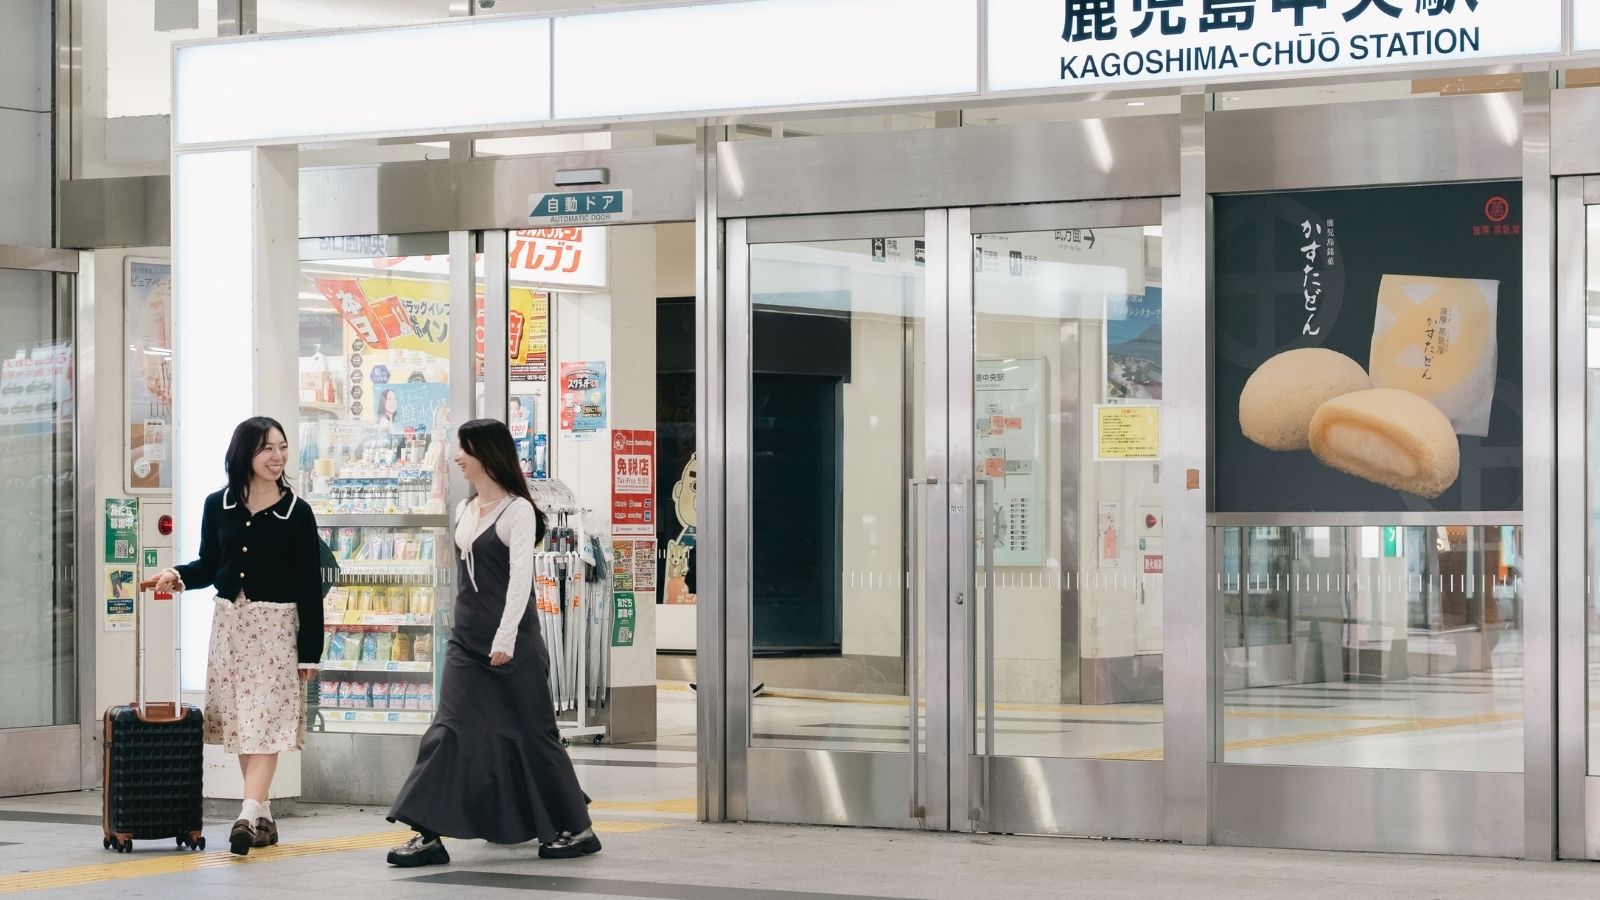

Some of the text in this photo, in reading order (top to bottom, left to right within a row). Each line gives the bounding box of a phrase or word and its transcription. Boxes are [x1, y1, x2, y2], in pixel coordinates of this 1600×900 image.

[1062, 0, 1480, 43] 鹿児島
[1060, 26, 1480, 79] KAGOSHIMA-CHŪŌ STATION
[547, 195, 614, 212] 自動ドア
[550, 215, 589, 223] AUTOMATIC
[1301, 219, 1321, 336] かすたどん
[1421, 317, 1437, 380] かすたどん
[617, 457, 649, 476] 免税店
